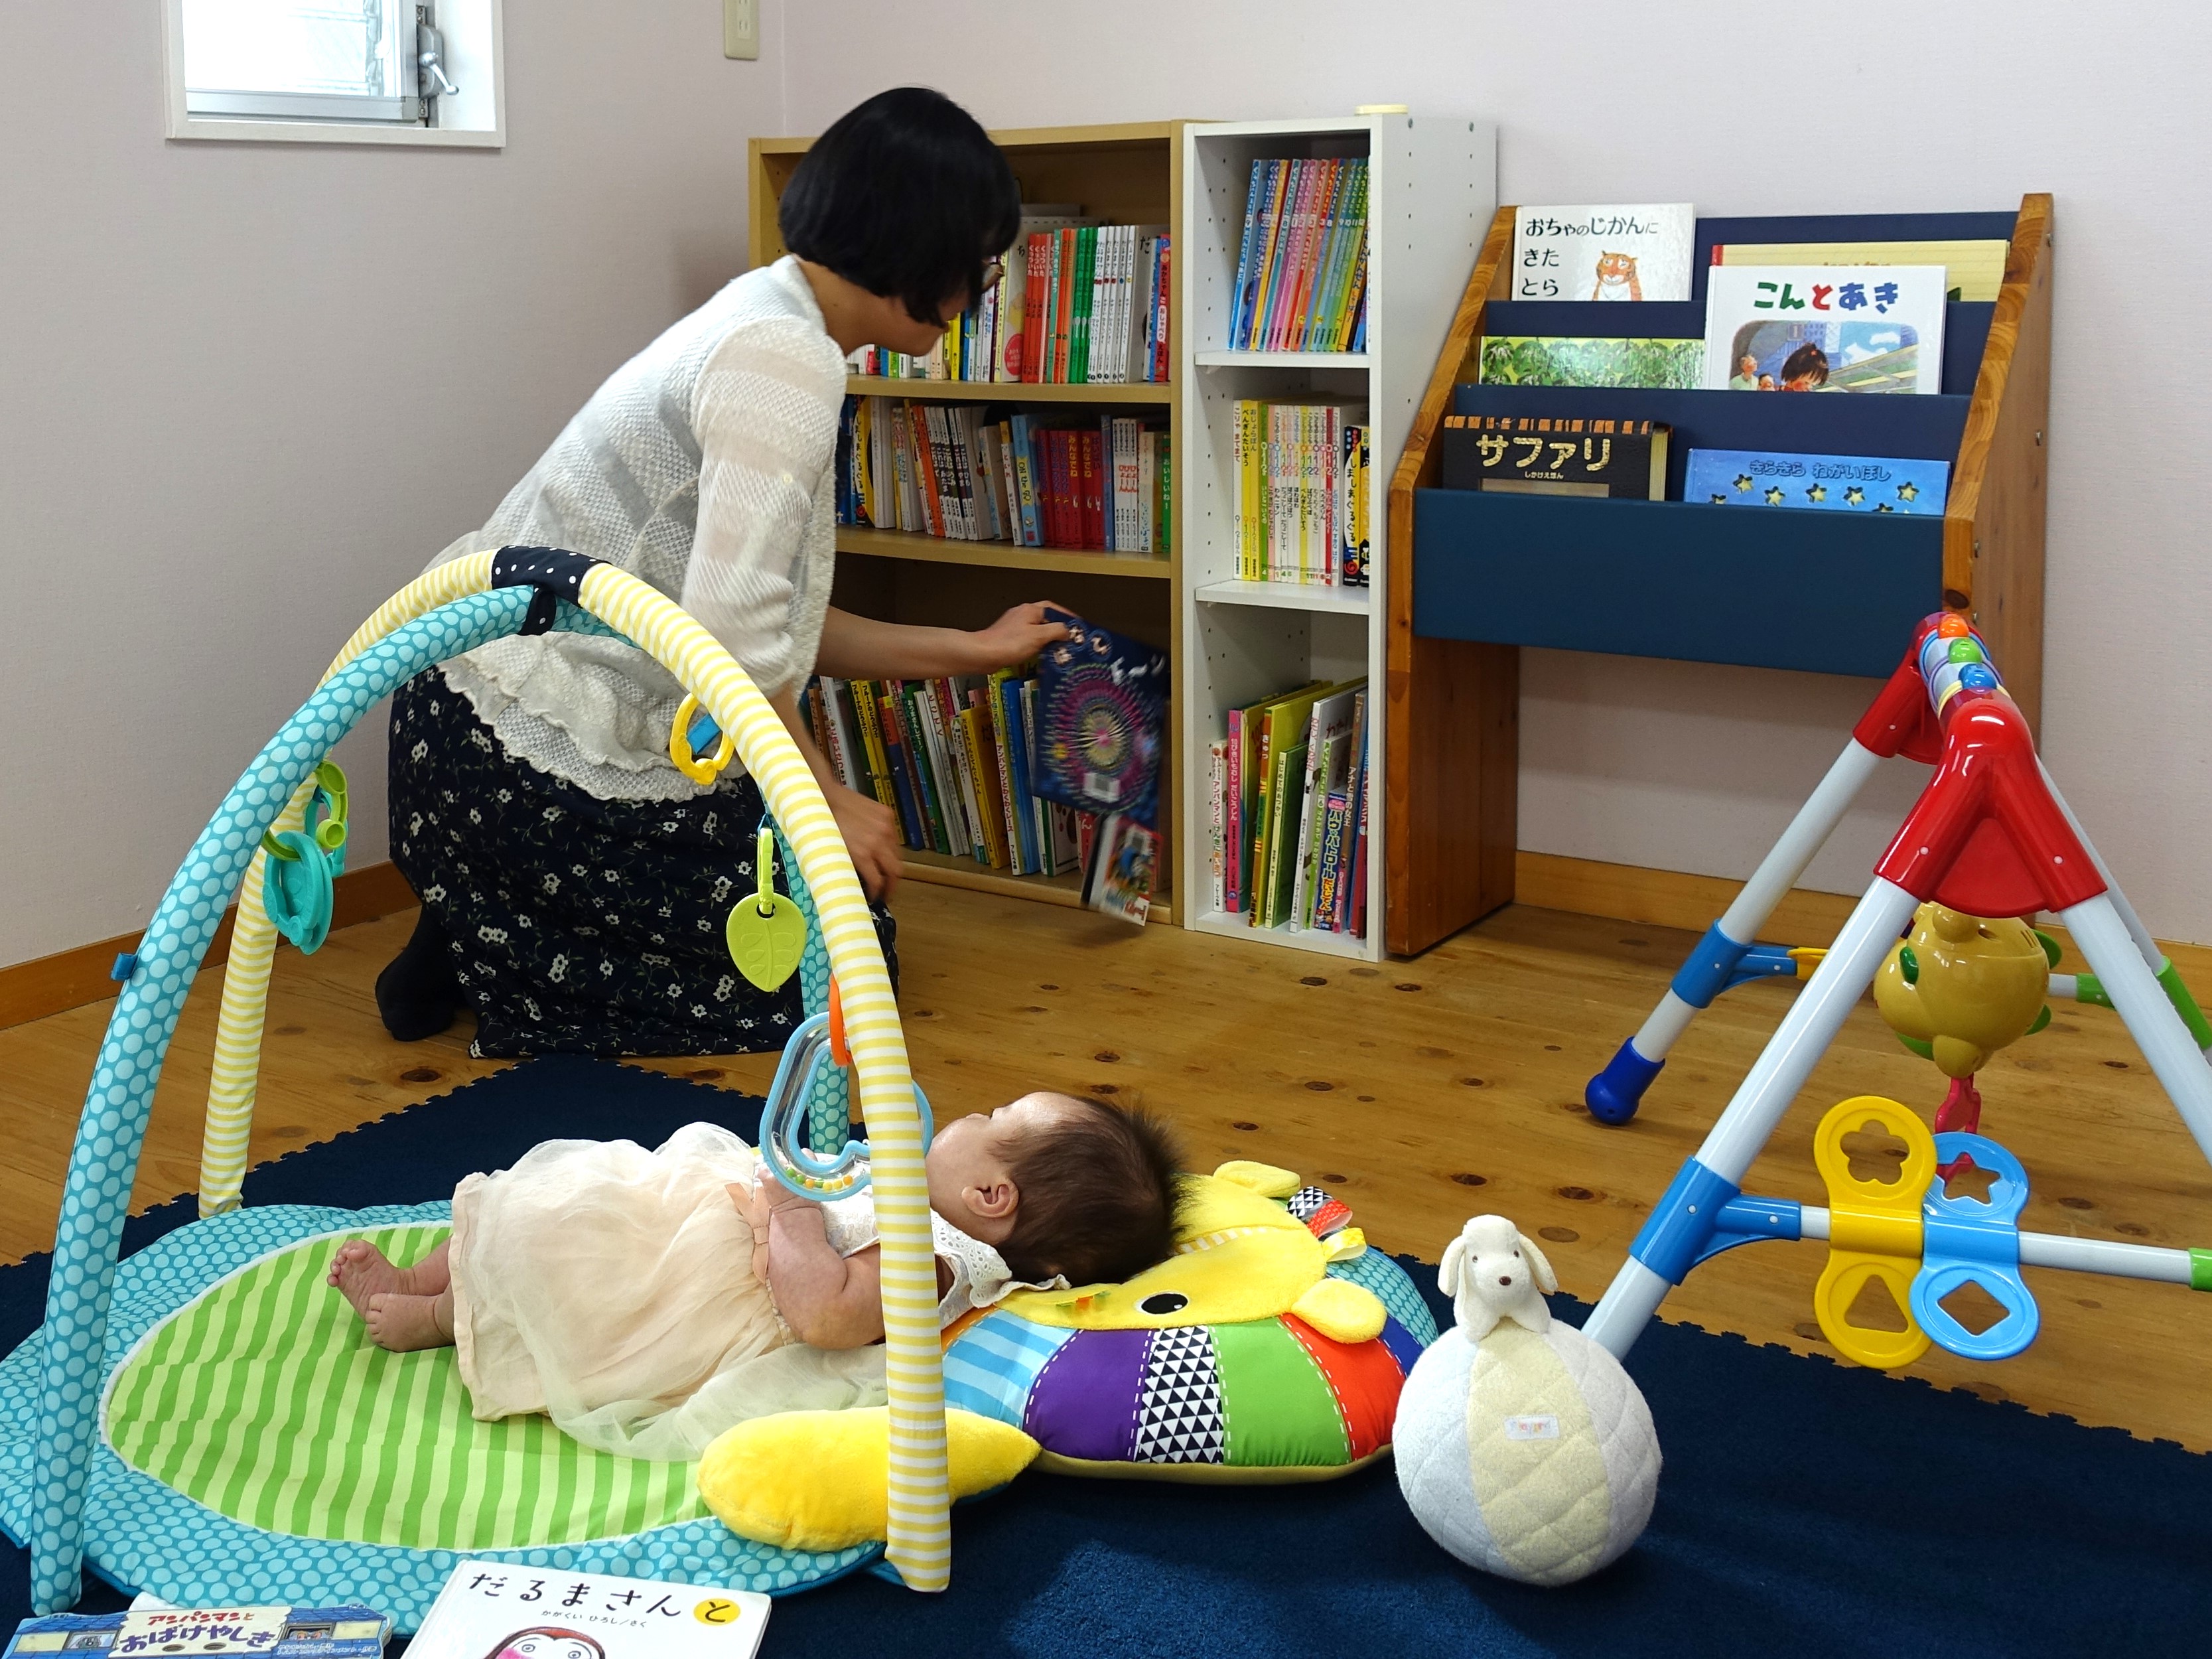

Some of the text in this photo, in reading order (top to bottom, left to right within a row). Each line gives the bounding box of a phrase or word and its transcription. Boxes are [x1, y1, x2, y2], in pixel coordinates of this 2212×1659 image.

[1526, 216, 1659, 237] おちゃのじかんに
[1524, 248, 1560, 267] きた
[1521, 278, 1558, 297] とら
[1754, 282, 1898, 314] こんとあき
[1476, 434, 1610, 471] サファリ
[1750, 460, 1806, 477] きらきら
[469, 1573, 730, 1623] だるまさん と
[148, 1611, 255, 1626] アンパンマンと
[541, 1611, 583, 1620] かがくい
[119, 1623, 277, 1654] おばけやしき
